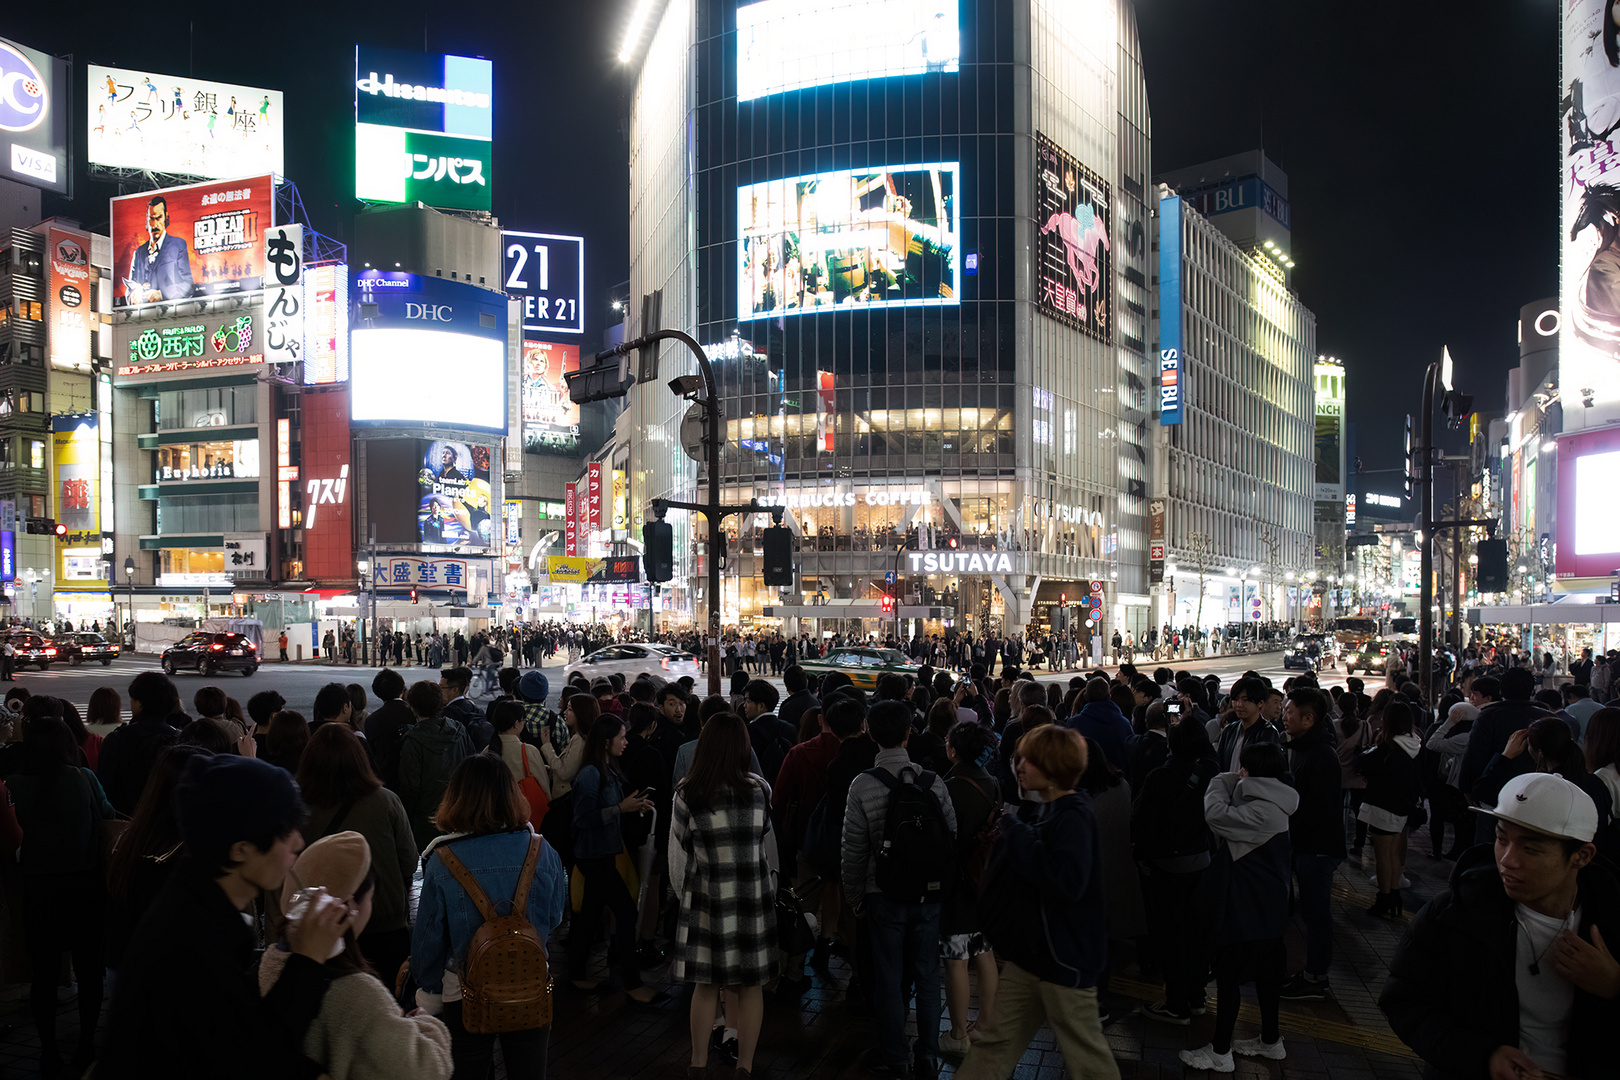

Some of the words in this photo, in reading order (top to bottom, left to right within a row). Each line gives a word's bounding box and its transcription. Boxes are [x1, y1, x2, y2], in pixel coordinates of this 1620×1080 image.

[18, 153, 52, 174] VISA
[1263, 187, 1289, 226] SEIBU
[506, 243, 549, 290] 21
[267, 229, 300, 359] もんじゃ
[357, 279, 376, 288] DHC
[376, 278, 409, 288] Channel
[406, 302, 453, 322] DHC
[525, 296, 549, 319] ER
[555, 299, 576, 320] 21
[163, 334, 205, 359] 西村
[1160, 348, 1178, 412] SEIBU
[1315, 404, 1341, 415] NCH
[163, 464, 231, 481] Euphoria
[63, 478, 90, 510] 薬
[306, 463, 349, 529] クスリ
[433, 482, 477, 498] Planets
[590, 468, 599, 517] カラオケ
[757, 492, 856, 508] STARBUCKS
[865, 491, 931, 506] COFFEE
[1056, 503, 1105, 529] TSUTAYA
[1346, 493, 1356, 525] SEIBU
[567, 520, 576, 558] カラオ
[372, 560, 463, 585] 大盛堂書
[909, 552, 1013, 572] TSUTAYA
